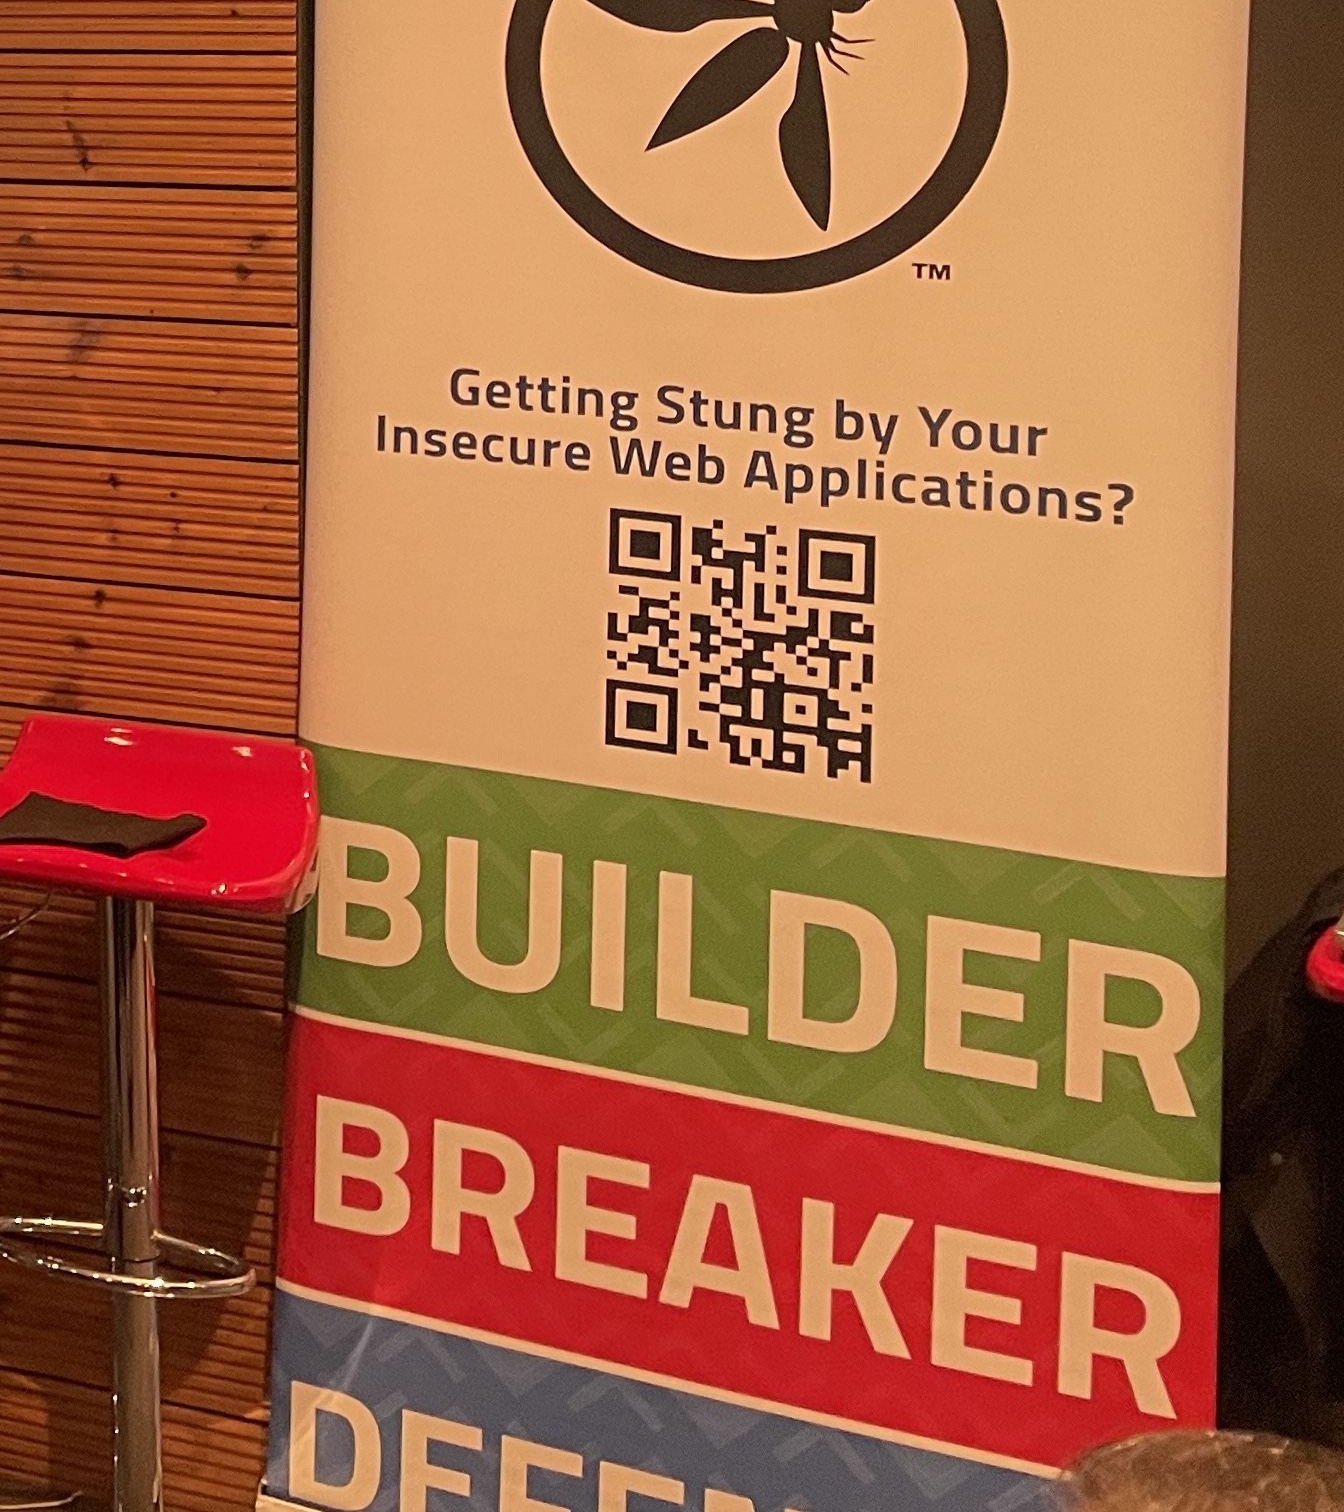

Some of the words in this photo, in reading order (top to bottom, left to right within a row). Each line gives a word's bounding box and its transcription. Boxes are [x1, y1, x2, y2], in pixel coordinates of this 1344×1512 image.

[377, 414, 591, 472] Insecure
[609, 435, 725, 485] Web
[743, 449, 1134, 527] Applications?
[450, 368, 639, 432] Getting
[656, 384, 815, 449] Stung
[835, 398, 899, 455] by
[917, 406, 1048, 457] Your
[315, 814, 1201, 1118] BUILDER
[314, 1094, 1182, 1420] BREAKER
